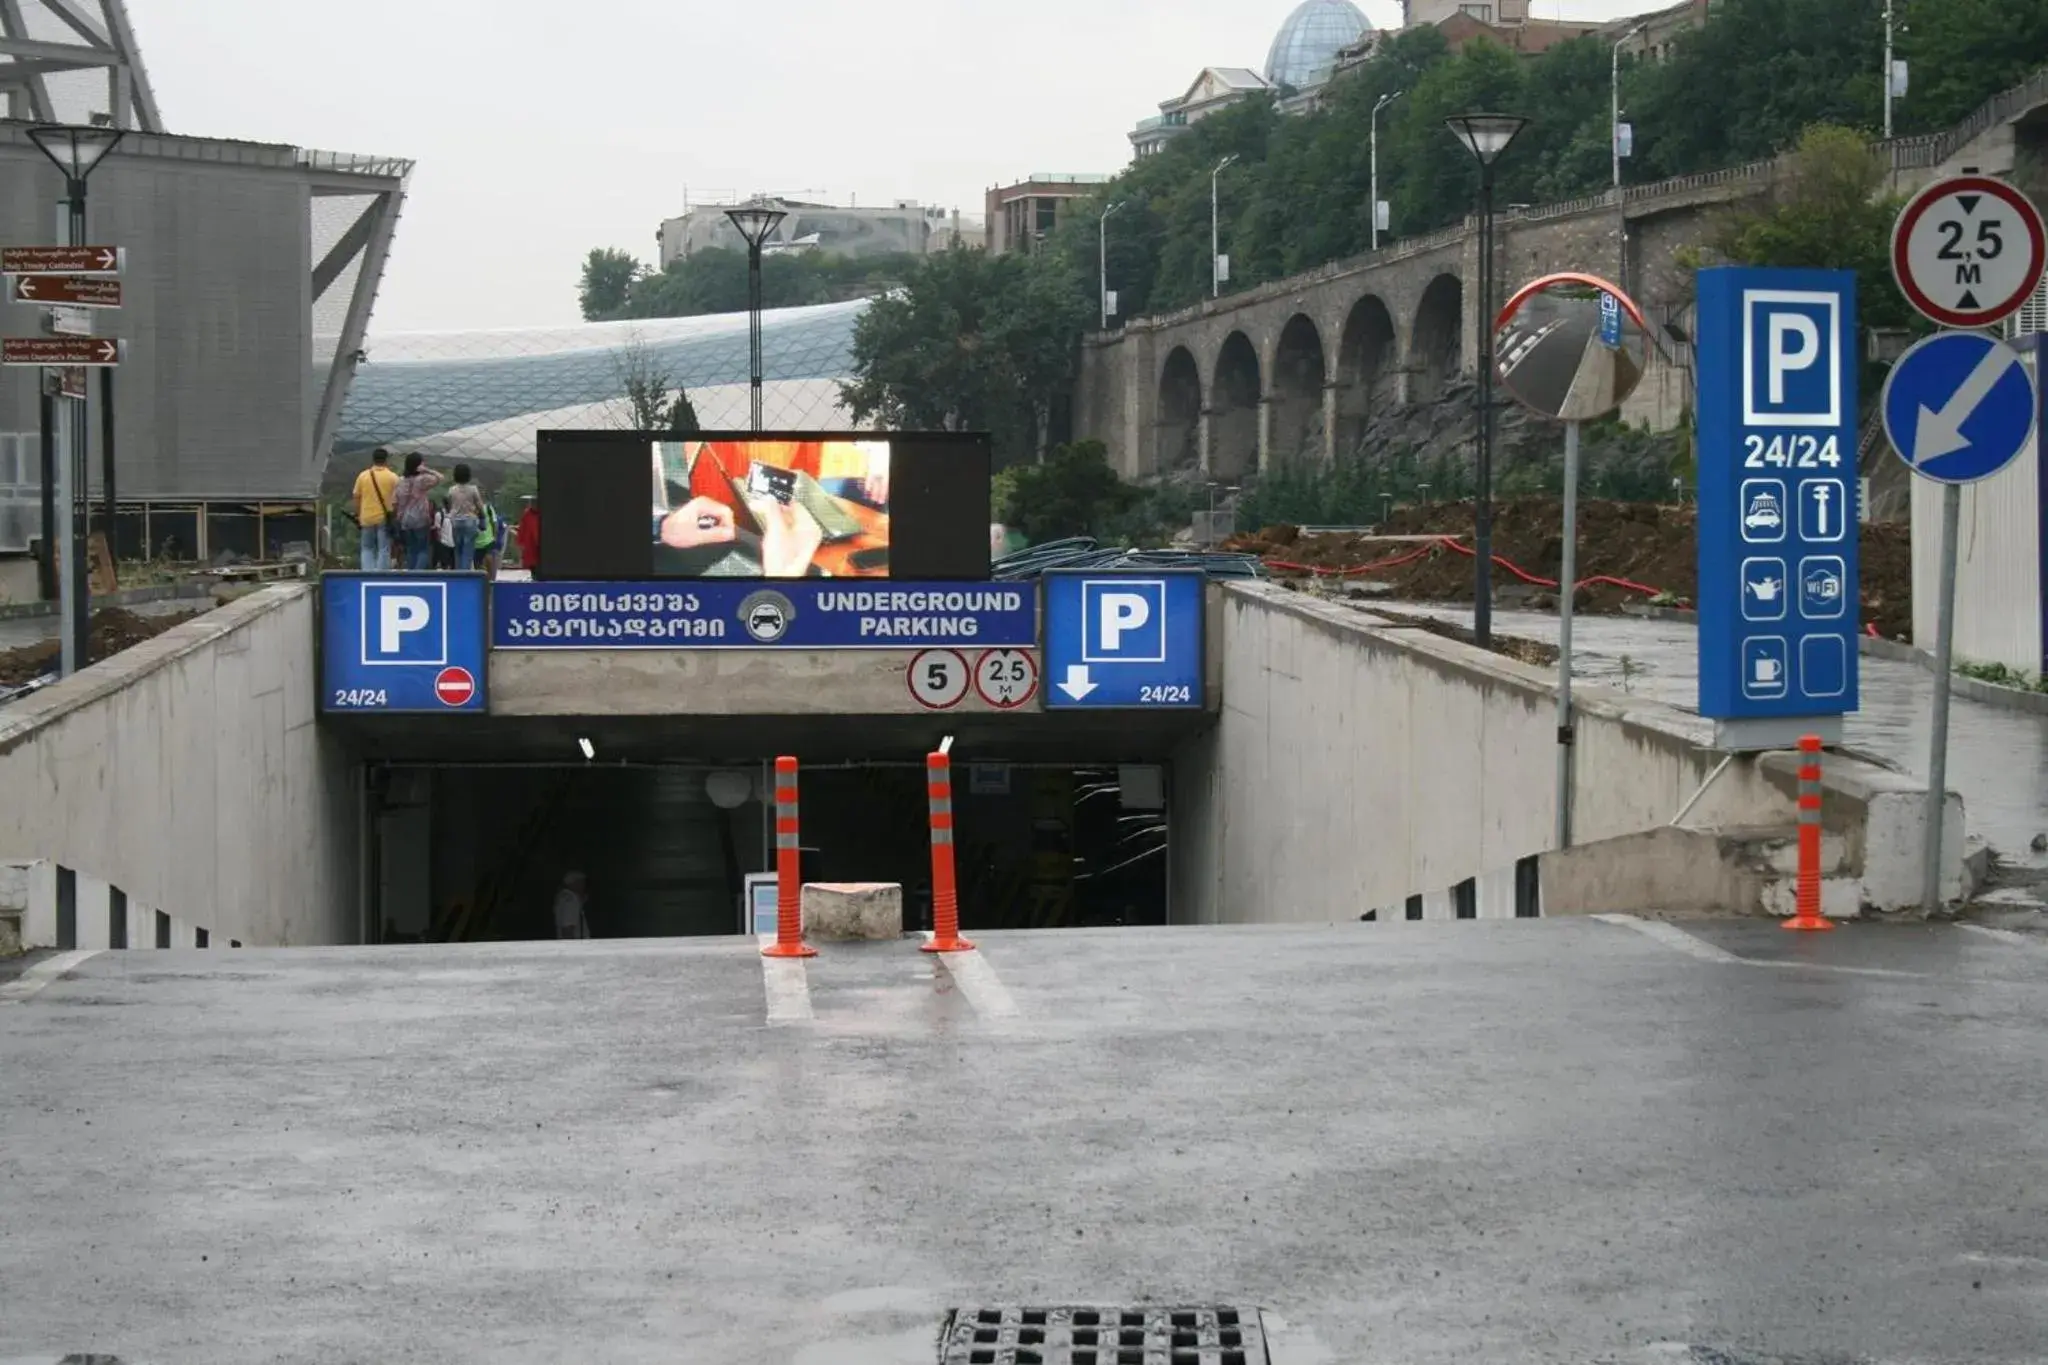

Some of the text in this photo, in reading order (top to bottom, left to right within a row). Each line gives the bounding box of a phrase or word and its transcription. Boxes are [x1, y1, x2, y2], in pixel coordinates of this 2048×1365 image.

[1936, 220, 2003, 262] 2,5
[1768, 312, 1819, 404] P
[1743, 435, 1840, 469] 24/24
[816, 591, 1021, 612] UNDERGROUND
[380, 596, 430, 652] P
[507, 617, 725, 637] ავტოსადგომი
[859, 616, 978, 637] PARKING
[1100, 593, 1149, 650] P
[927, 664, 948, 691] 5
[334, 689, 388, 707] 24/24
[1139, 686, 1190, 703] 24/24
